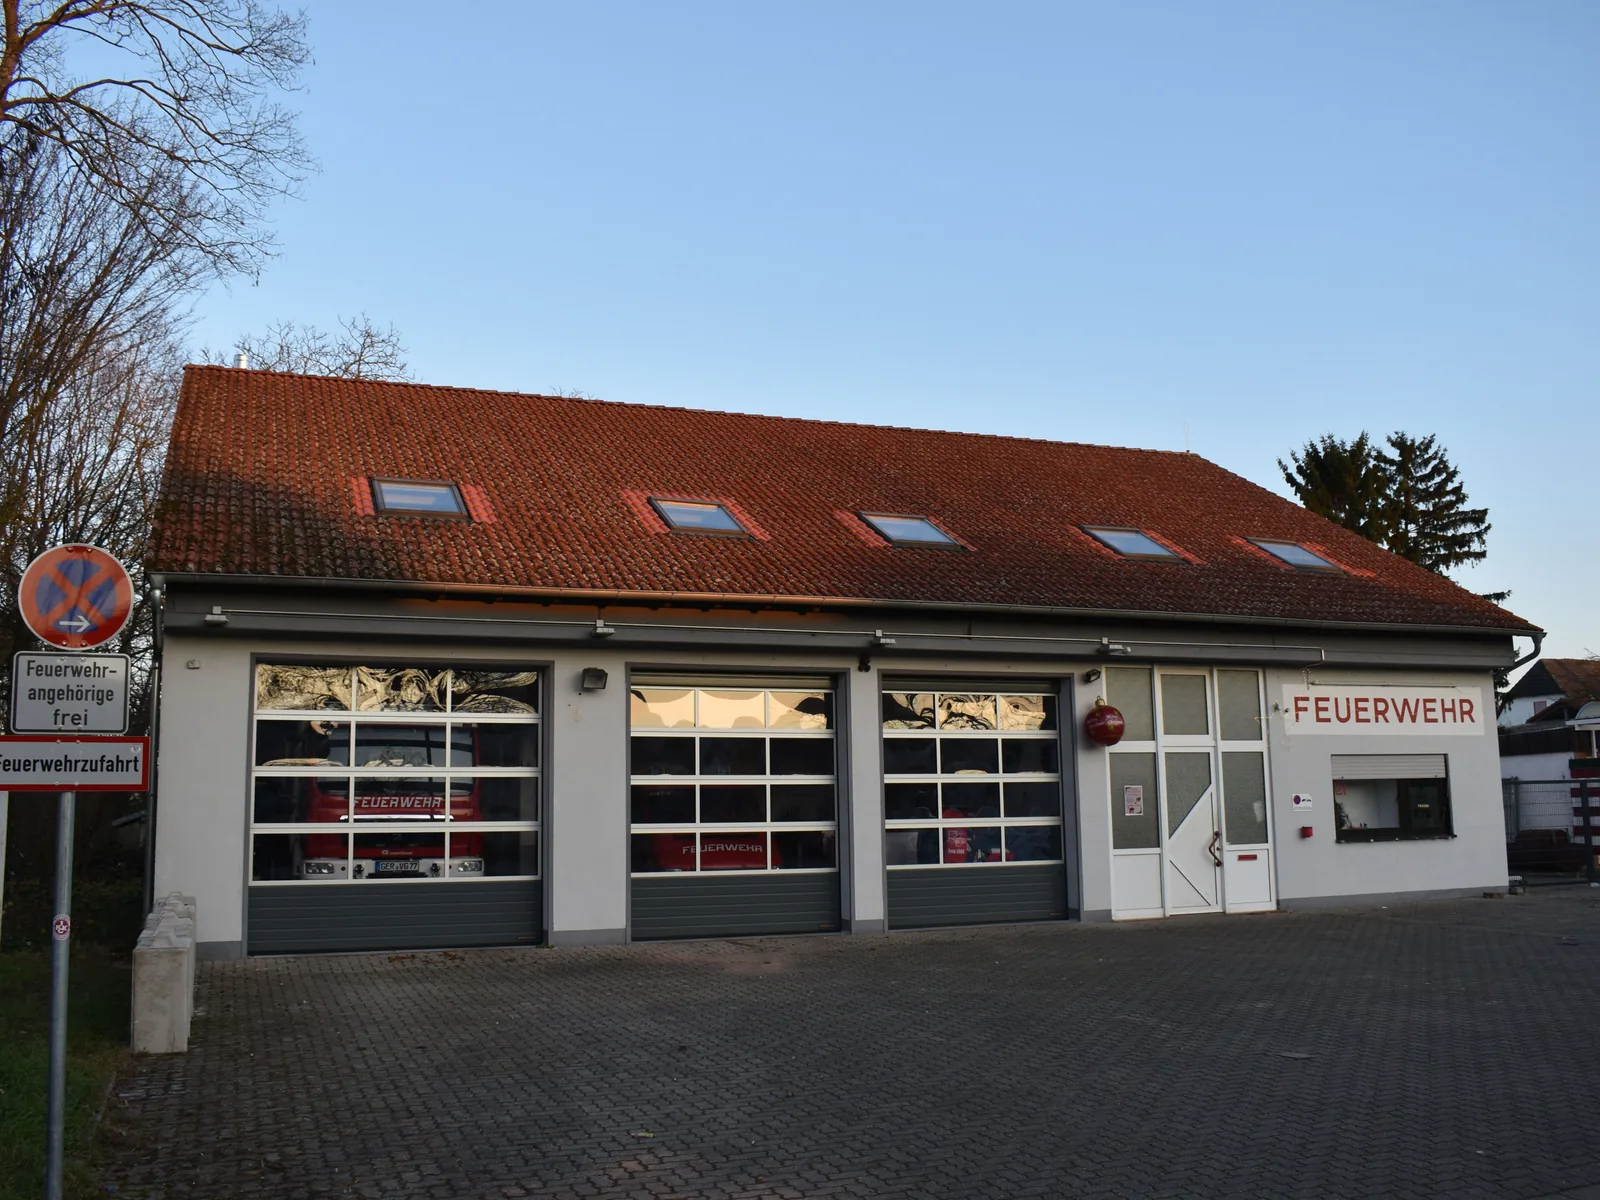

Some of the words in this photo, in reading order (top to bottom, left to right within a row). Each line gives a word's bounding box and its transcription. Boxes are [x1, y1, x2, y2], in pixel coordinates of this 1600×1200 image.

[27, 660, 117, 678] Feuerwehr-
[28, 684, 114, 705] angehörige
[53, 709, 88, 726] frei
[1294, 696, 1475, 723] FEUERWEHR
[0, 754, 139, 772] euerwehrzufahrt
[354, 796, 441, 808] FEUERWEHR
[682, 843, 763, 855] FEUERWEHR
[380, 862, 395, 870] GER
